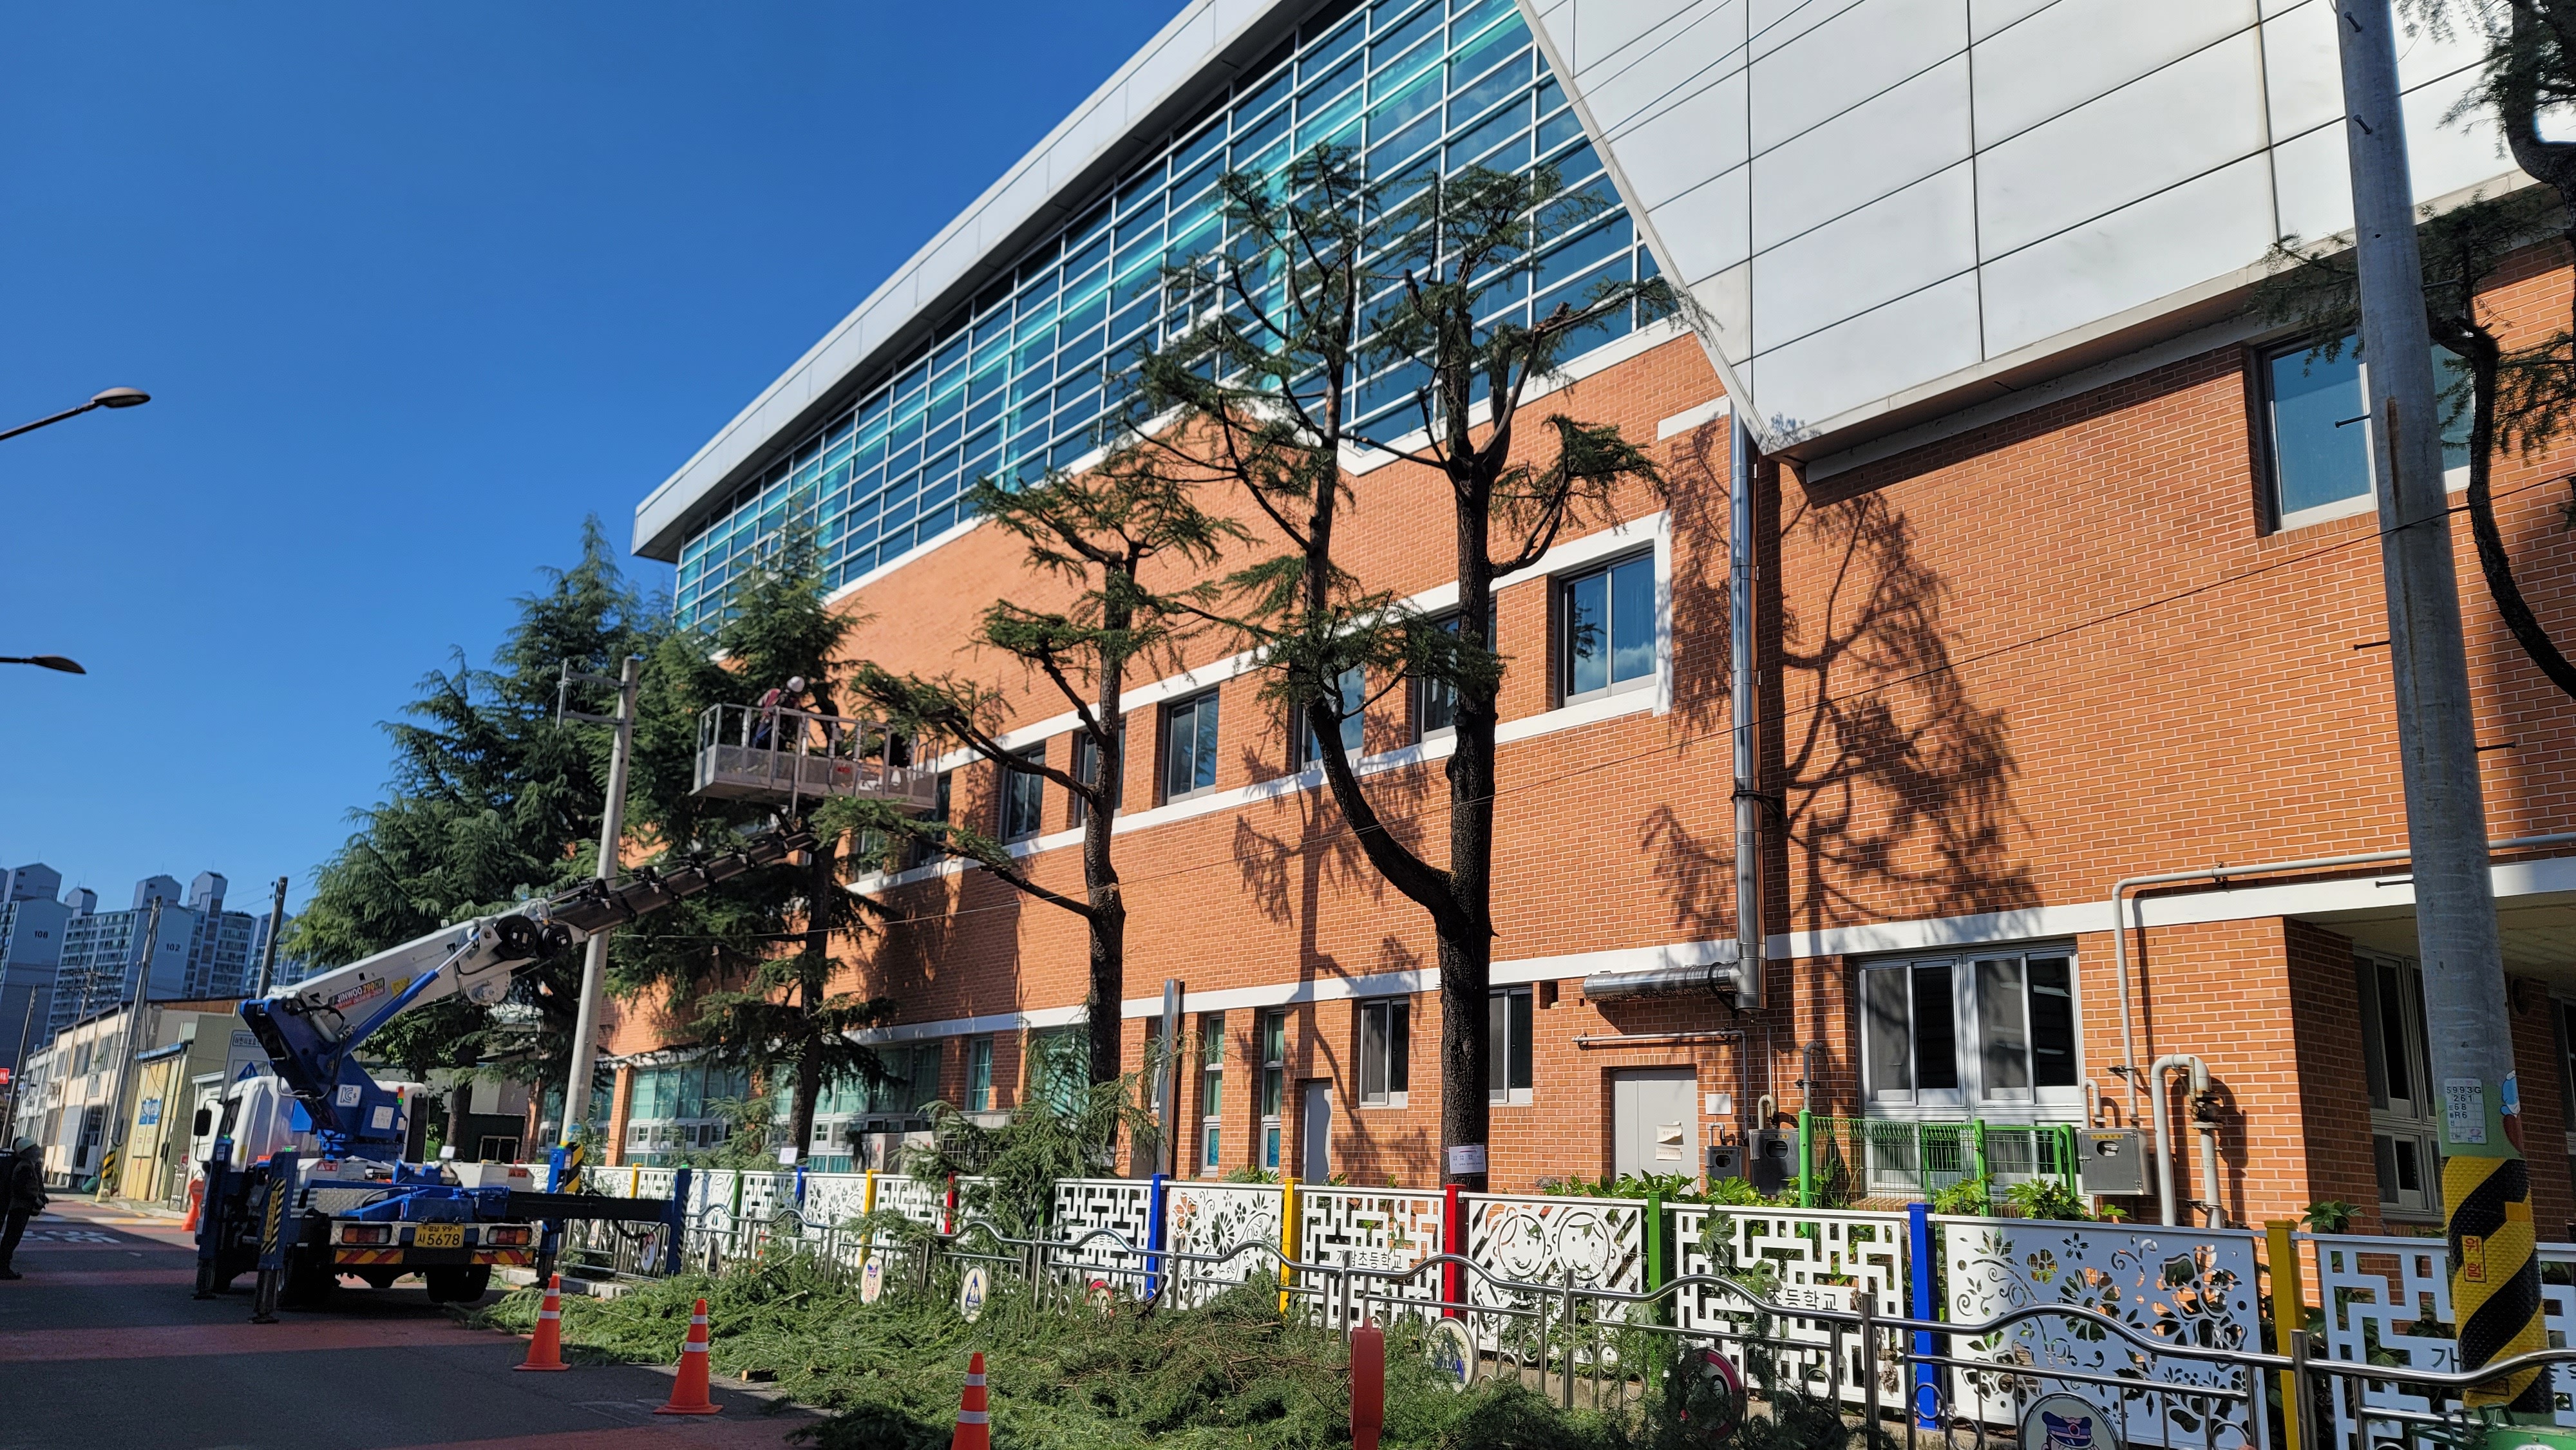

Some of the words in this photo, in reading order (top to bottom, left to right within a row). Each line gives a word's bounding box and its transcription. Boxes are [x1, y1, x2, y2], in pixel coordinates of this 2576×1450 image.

[166, 943, 180, 952] 102
[337, 986, 363, 1003] JINWOO
[2465, 1238, 2482, 1278] 위험
